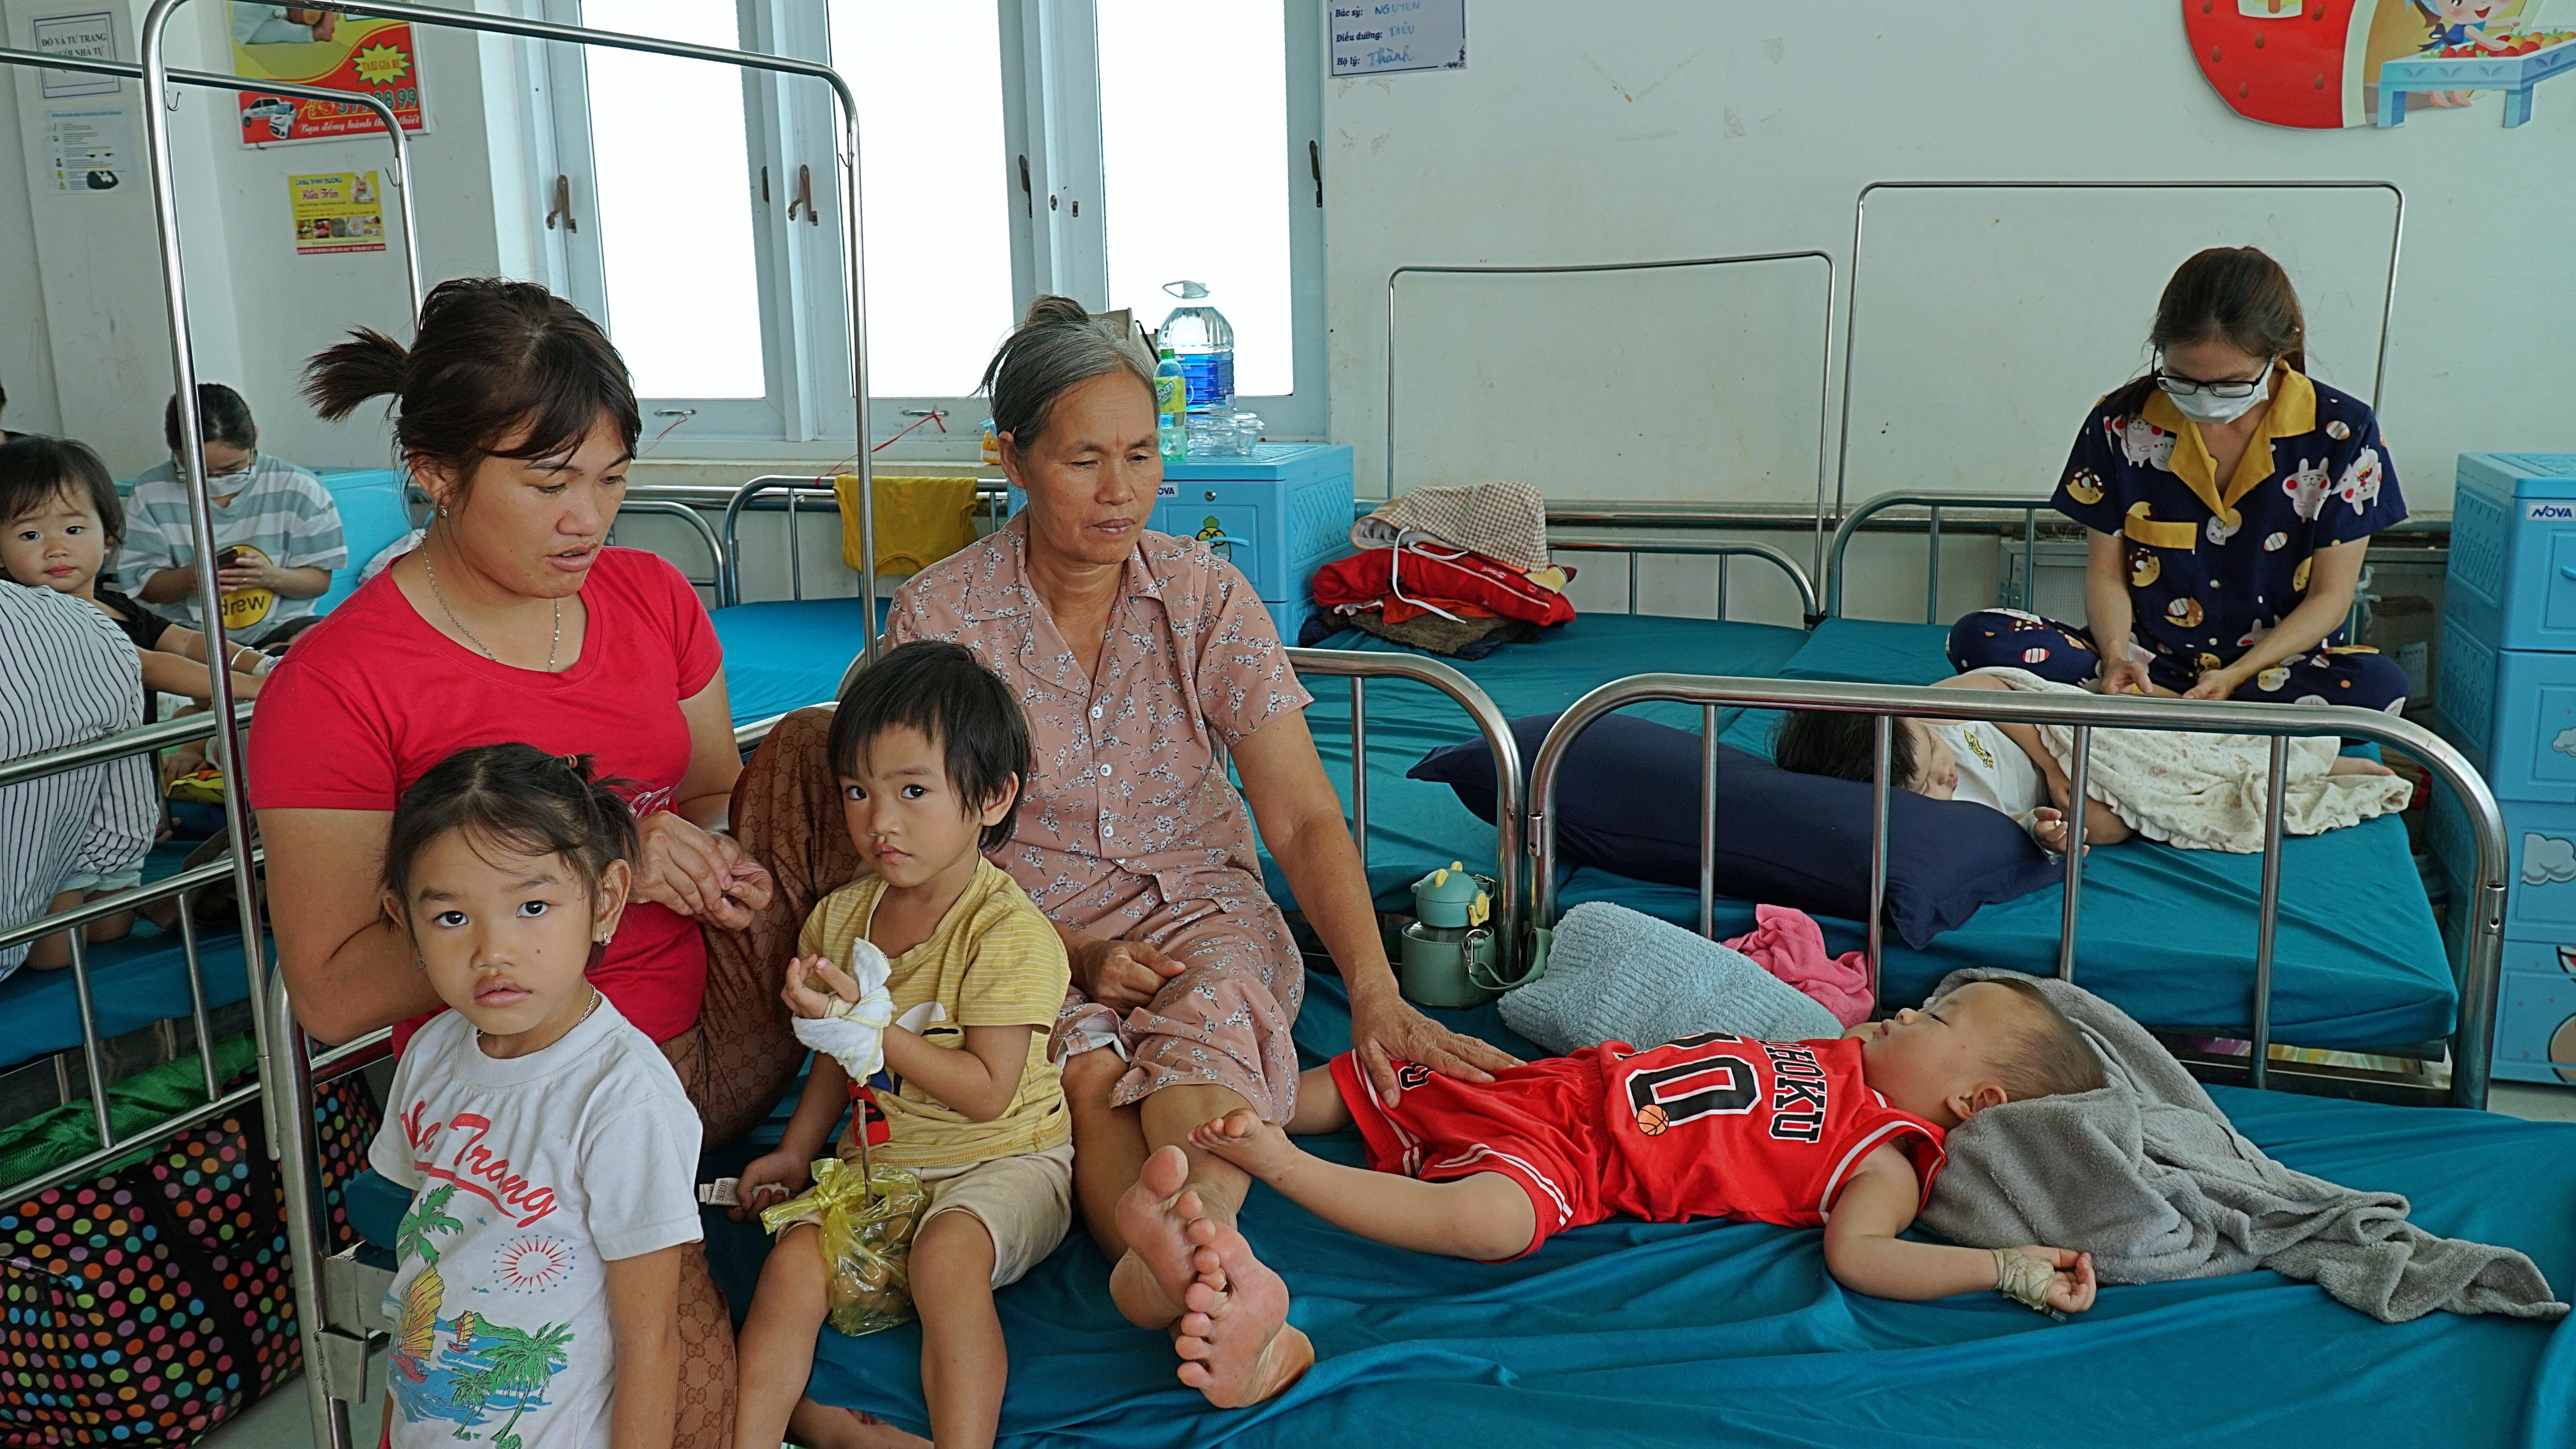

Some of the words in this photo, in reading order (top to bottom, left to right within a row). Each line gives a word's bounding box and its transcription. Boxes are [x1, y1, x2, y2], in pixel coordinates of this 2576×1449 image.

[1335, 9, 1349, 17] Bác
[79, 33, 106, 43] TRANG
[1337, 58, 1347, 67] Hộ
[2531, 506, 2572, 518] NOVA
[449, 1113, 558, 1228] Trang
[715, 1180, 728, 1201] 2000
